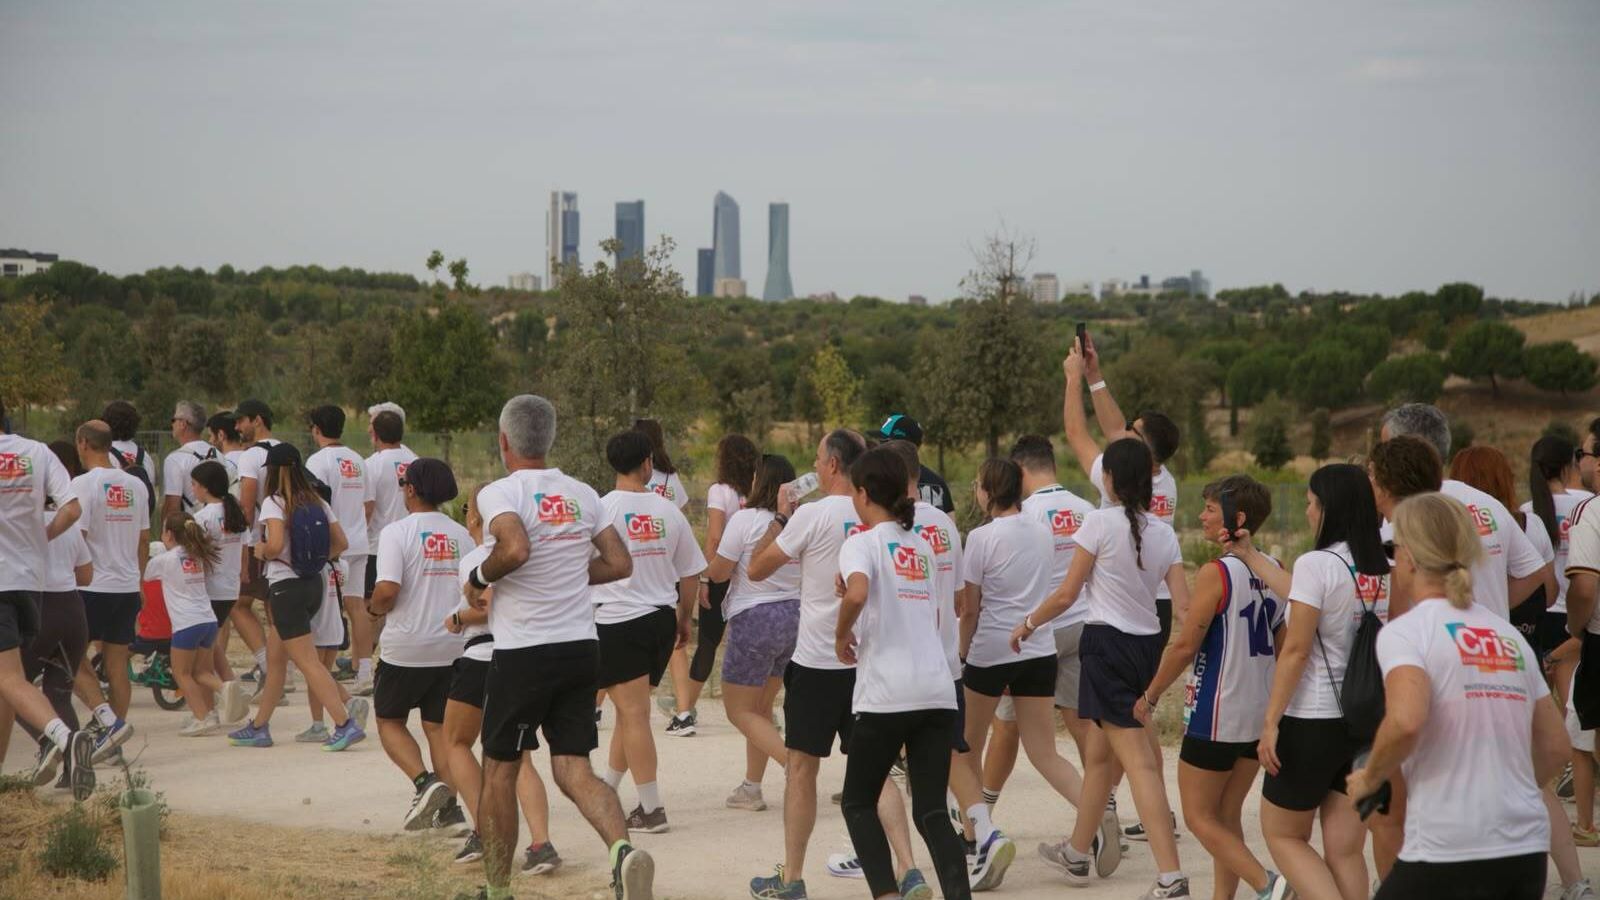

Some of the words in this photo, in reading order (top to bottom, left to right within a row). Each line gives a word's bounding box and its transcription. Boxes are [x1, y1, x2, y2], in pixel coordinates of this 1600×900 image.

[538, 497, 578, 517] Cris
[628, 516, 663, 534] Cris
[424, 535, 457, 553] Cris
[893, 547, 928, 573] Cris
[1455, 627, 1521, 660] Cris
